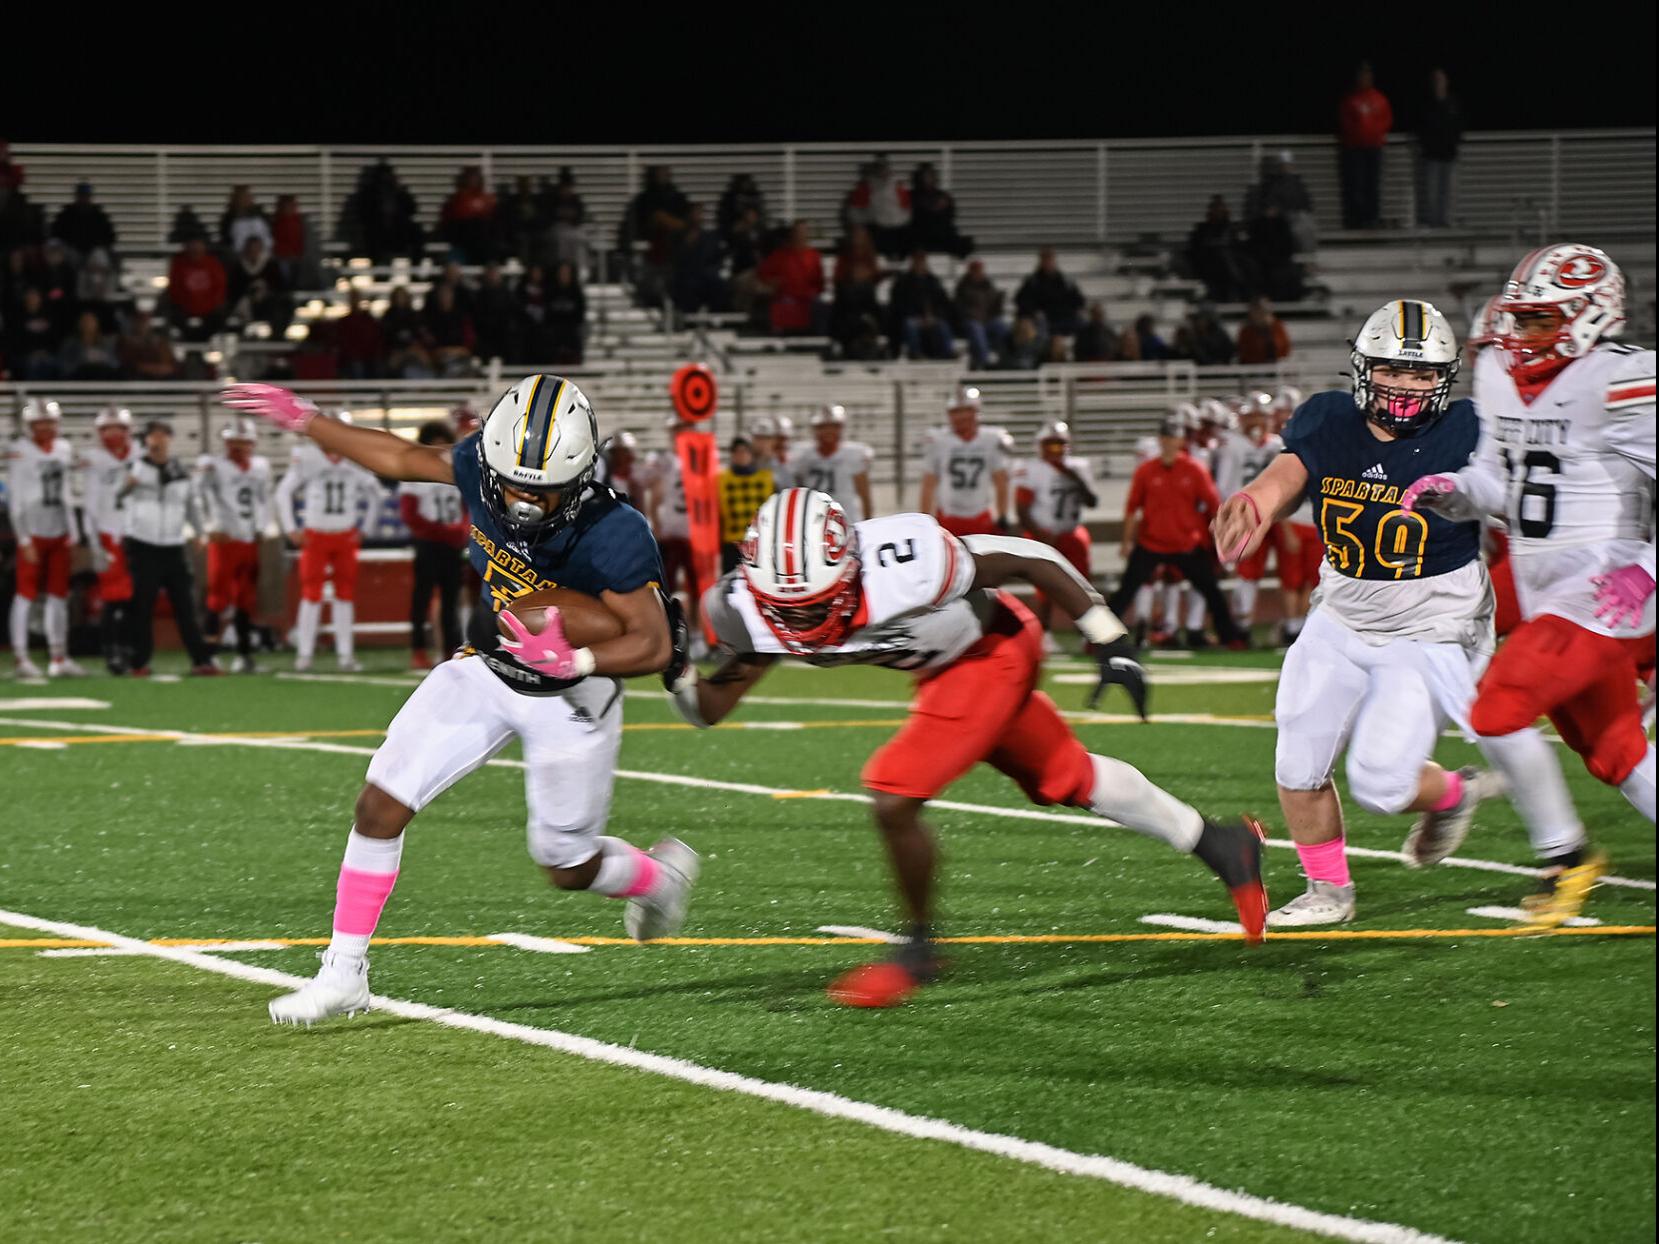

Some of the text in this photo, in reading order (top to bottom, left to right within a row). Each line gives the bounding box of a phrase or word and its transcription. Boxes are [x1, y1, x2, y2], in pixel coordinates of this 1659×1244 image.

[949, 457, 985, 489] 57
[1362, 471, 1388, 480] adidas
[238, 487, 254, 518] 9
[325, 481, 345, 513] 11
[877, 538, 916, 568] 2
[1321, 498, 1428, 579] 59
